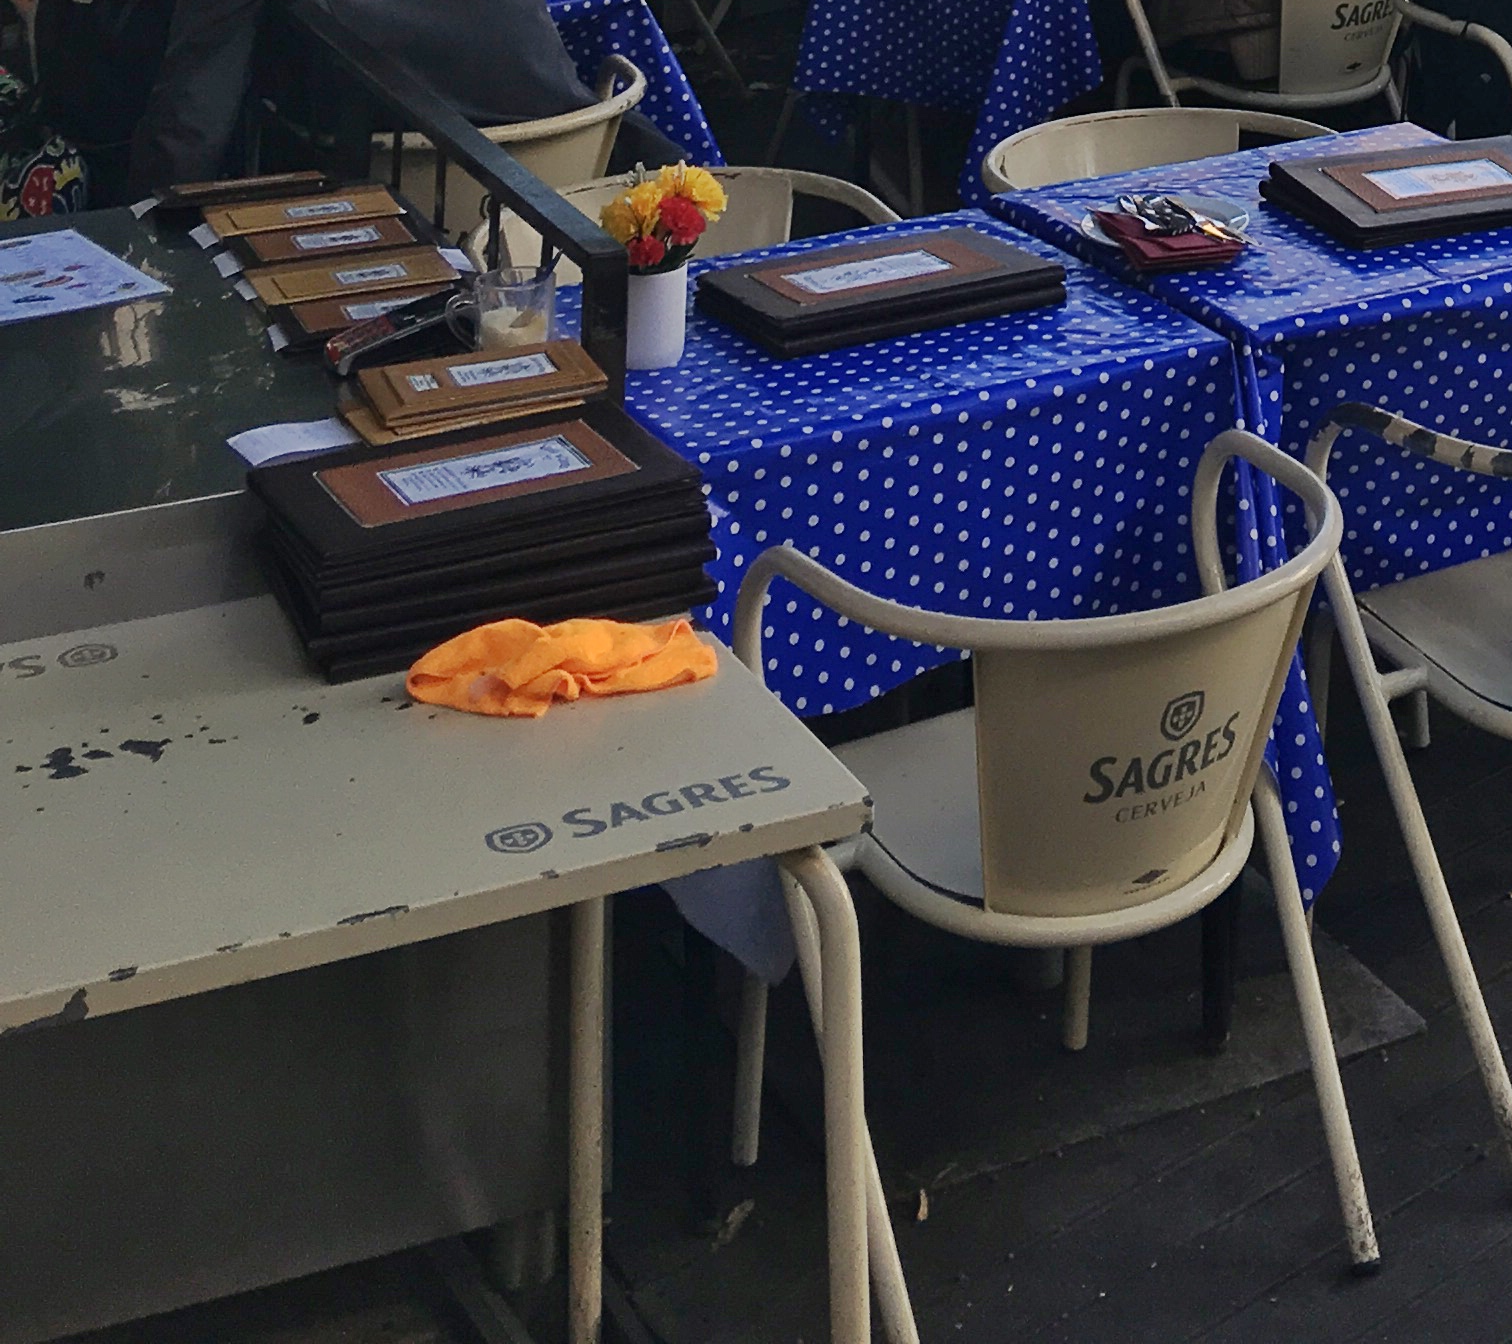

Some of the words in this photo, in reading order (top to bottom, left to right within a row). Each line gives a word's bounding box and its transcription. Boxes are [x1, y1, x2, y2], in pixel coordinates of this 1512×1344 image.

[1083, 711, 1240, 804] SAGRES
[562, 766, 791, 838] SAGRES
[1115, 781, 1206, 823] CERVEJA
